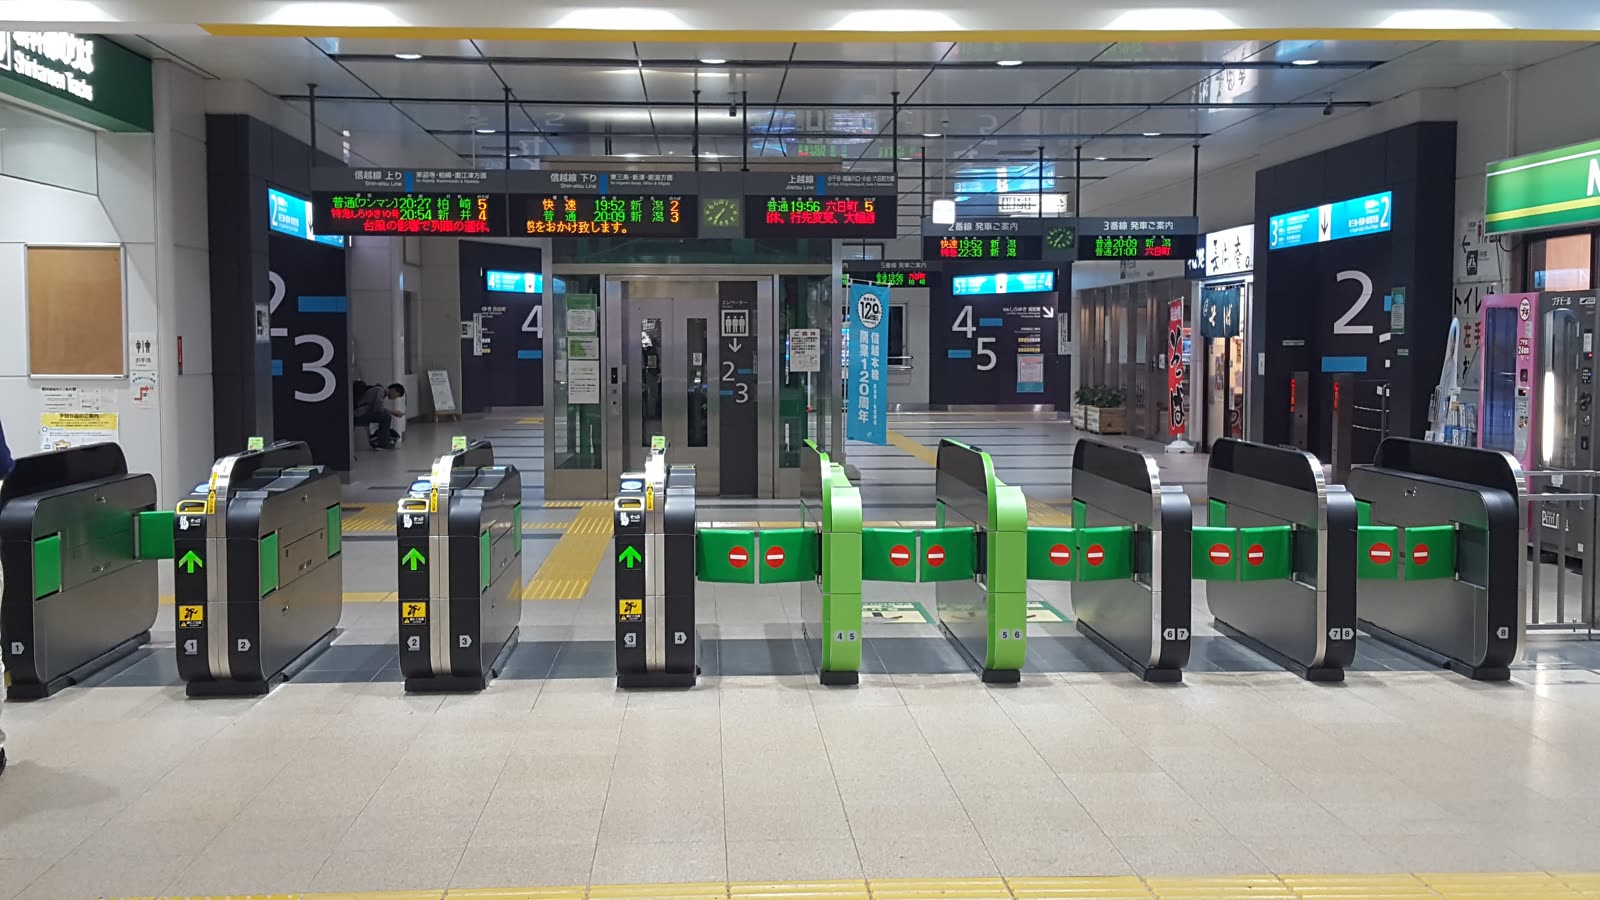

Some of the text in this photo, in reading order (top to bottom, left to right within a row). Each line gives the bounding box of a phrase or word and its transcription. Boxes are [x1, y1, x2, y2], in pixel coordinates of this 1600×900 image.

[354, 171, 402, 180] 信越線 上り
[550, 174, 596, 182] 信越線 下り
[788, 175, 814, 184] 上越線
[400, 198, 432, 209] 20:27
[478, 198, 487, 210] 5
[595, 200, 625, 211] 19:52
[670, 200, 680, 212] 2
[767, 200, 874, 212] 普通 19:56 六日町 5
[400, 209, 432, 220] 20:54
[478, 209, 488, 221] 4
[594, 212, 625, 222] 20:09
[670, 212, 680, 223] 3
[1380, 196, 1389, 228] 2
[948, 222, 1018, 232] 2番線 発車ご案内
[1104, 221, 1174, 230] 3番線 発車ご案内
[1272, 220, 1278, 246] 3
[960, 240, 982, 248] 19:52
[1113, 239, 1138, 248] 20:09
[958, 249, 982, 258] 22:33
[1113, 248, 1136, 256] 21:00
[1145, 248, 1171, 256] 六日町
[1334, 270, 1374, 334] 2
[522, 305, 544, 338] 4
[952, 306, 976, 338] 4
[976, 337, 997, 371] 5
[294, 334, 336, 402] 3
[722, 361, 735, 382] 2
[736, 382, 748, 404] 3
